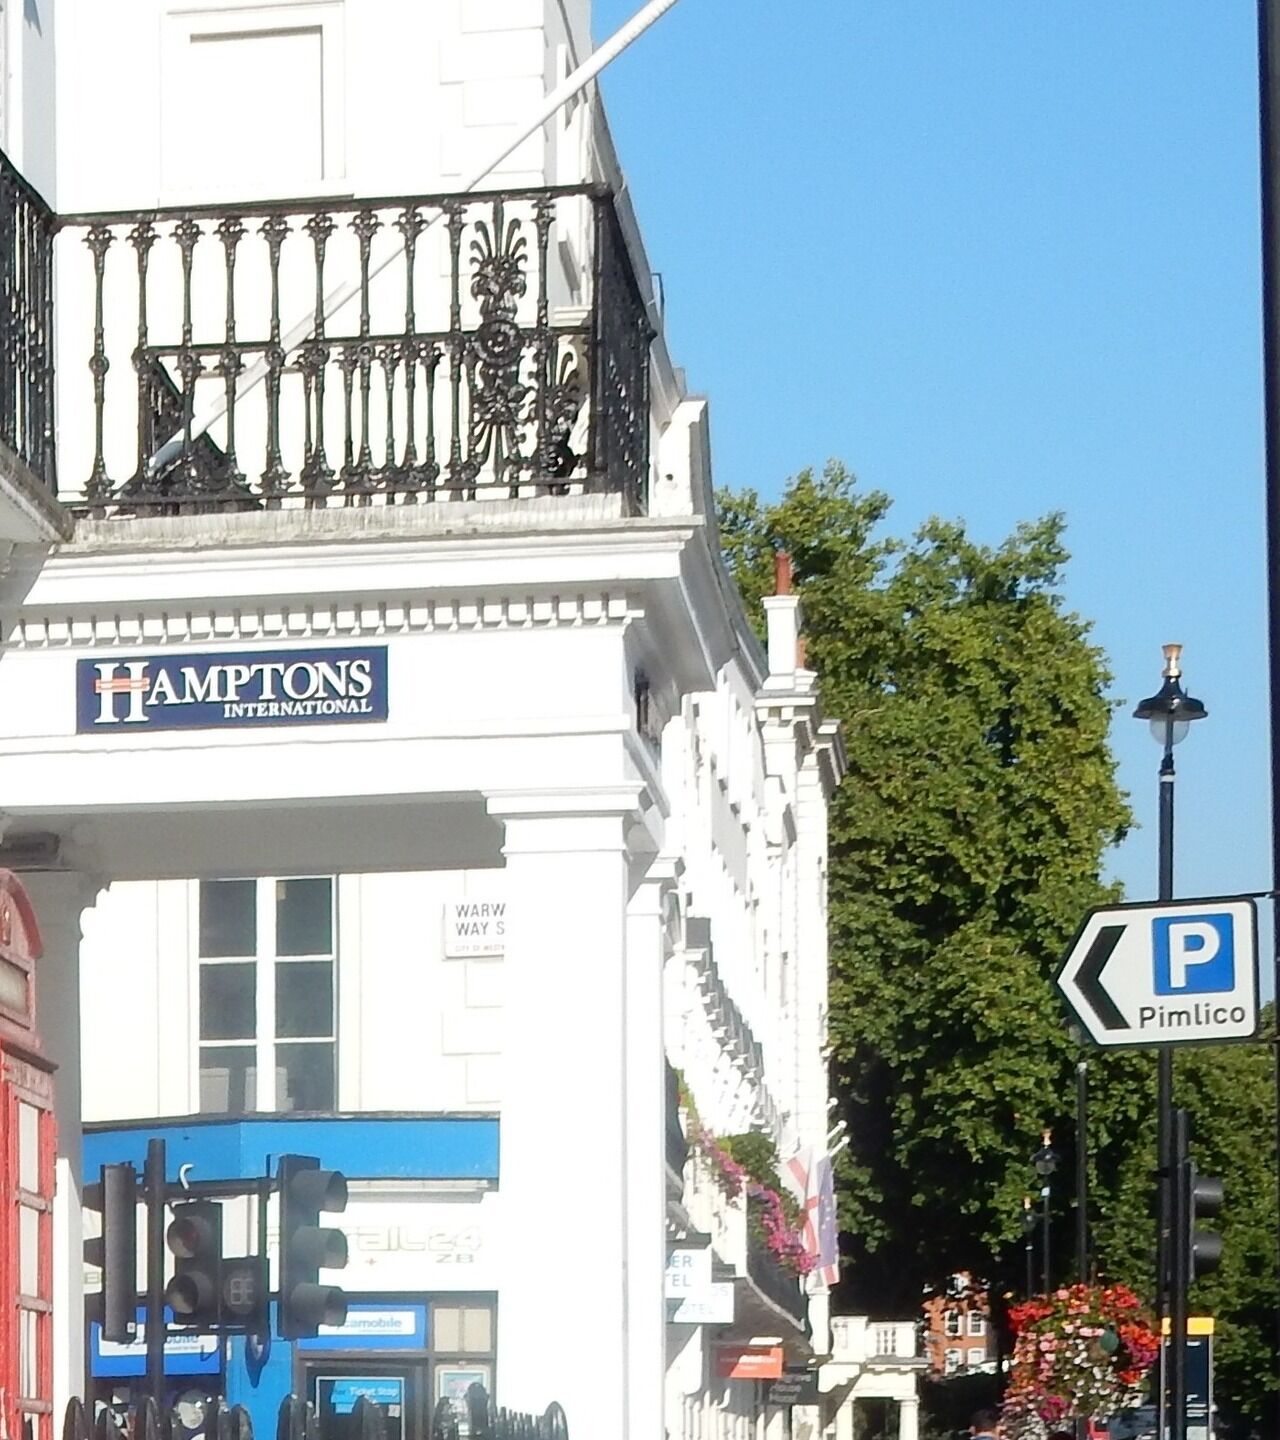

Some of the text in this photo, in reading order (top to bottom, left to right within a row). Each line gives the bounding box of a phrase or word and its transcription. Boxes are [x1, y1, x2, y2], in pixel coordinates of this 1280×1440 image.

[93, 660, 373, 724] HAMPTONS
[223, 699, 373, 719] INTERNATIONAL
[455, 921, 489, 936] WAY
[1168, 922, 1220, 988] P
[1139, 1002, 1246, 1029] Pimlico
